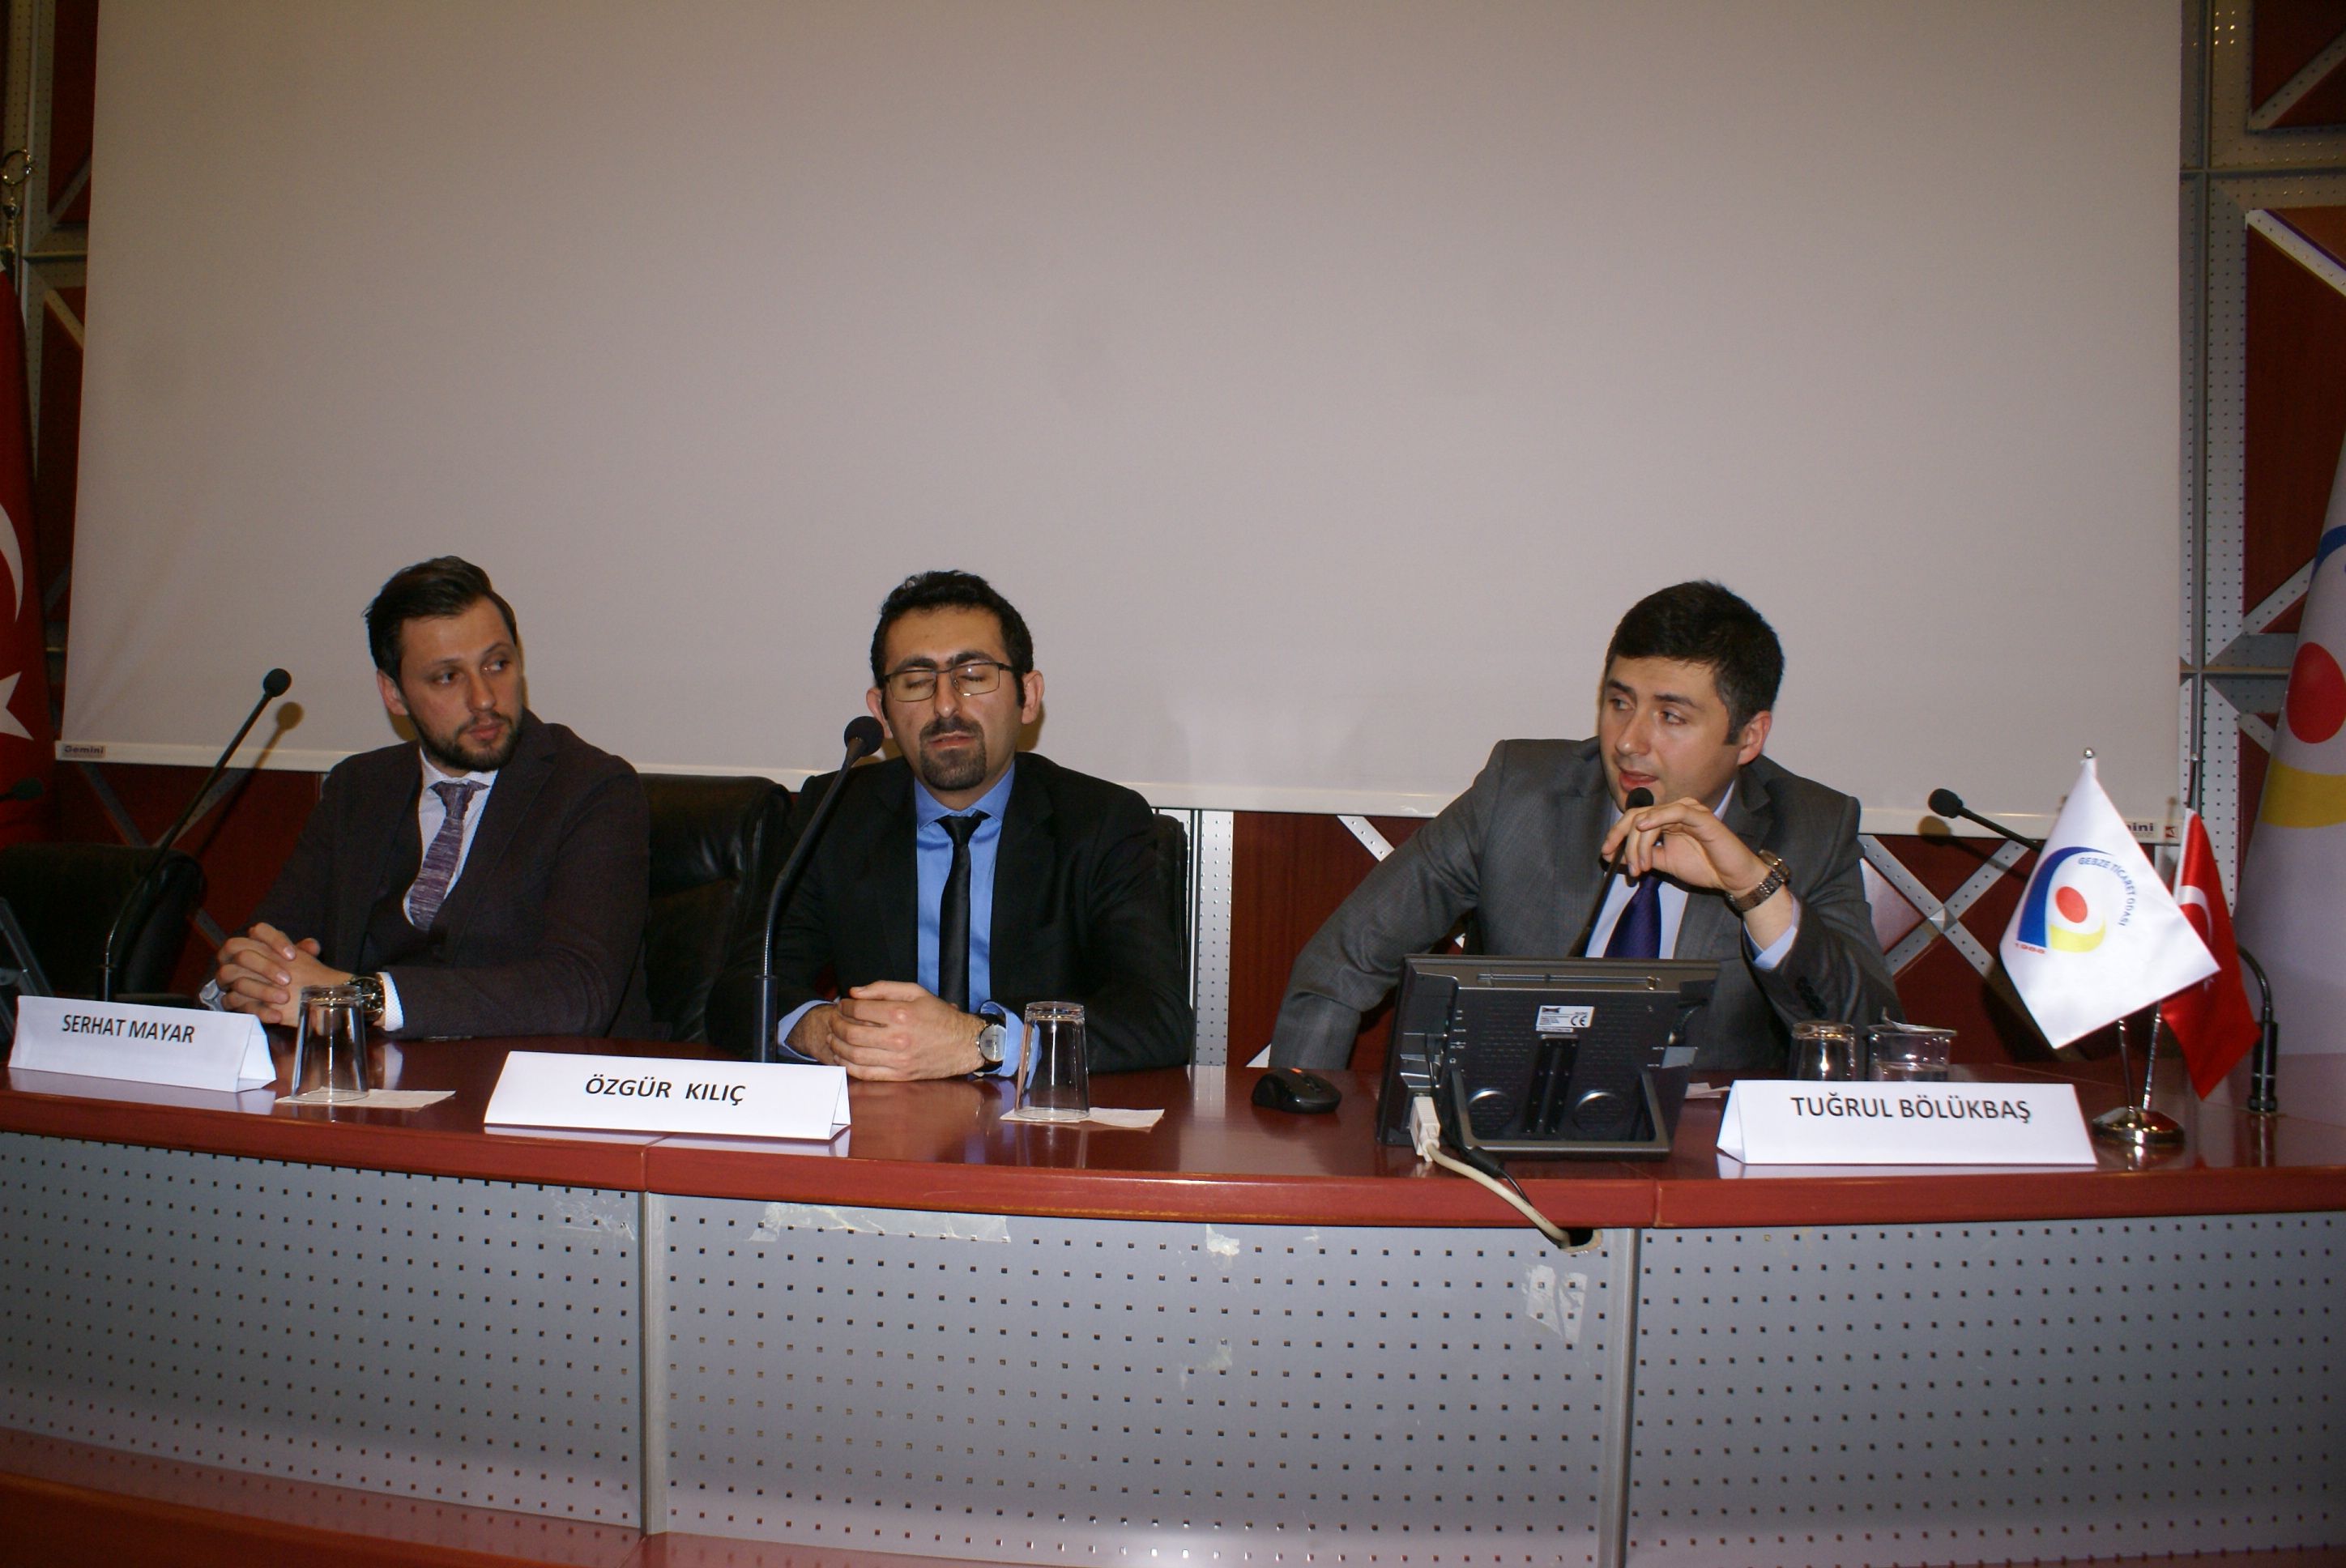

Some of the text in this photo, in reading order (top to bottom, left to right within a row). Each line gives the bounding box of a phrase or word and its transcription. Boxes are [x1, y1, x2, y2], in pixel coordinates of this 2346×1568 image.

[64, 745, 104, 753] Gemini
[2078, 857, 2111, 869] GEBZE
[2118, 897, 2135, 926] ODASI
[62, 1014, 195, 1044] SERHAT MAYAR
[1571, 1015, 1587, 1027] CE
[585, 1073, 746, 1106] ÖZGÜR KILIÇ
[1790, 1091, 2031, 1124] TUĞRUL BÖLÜKBAŞ
